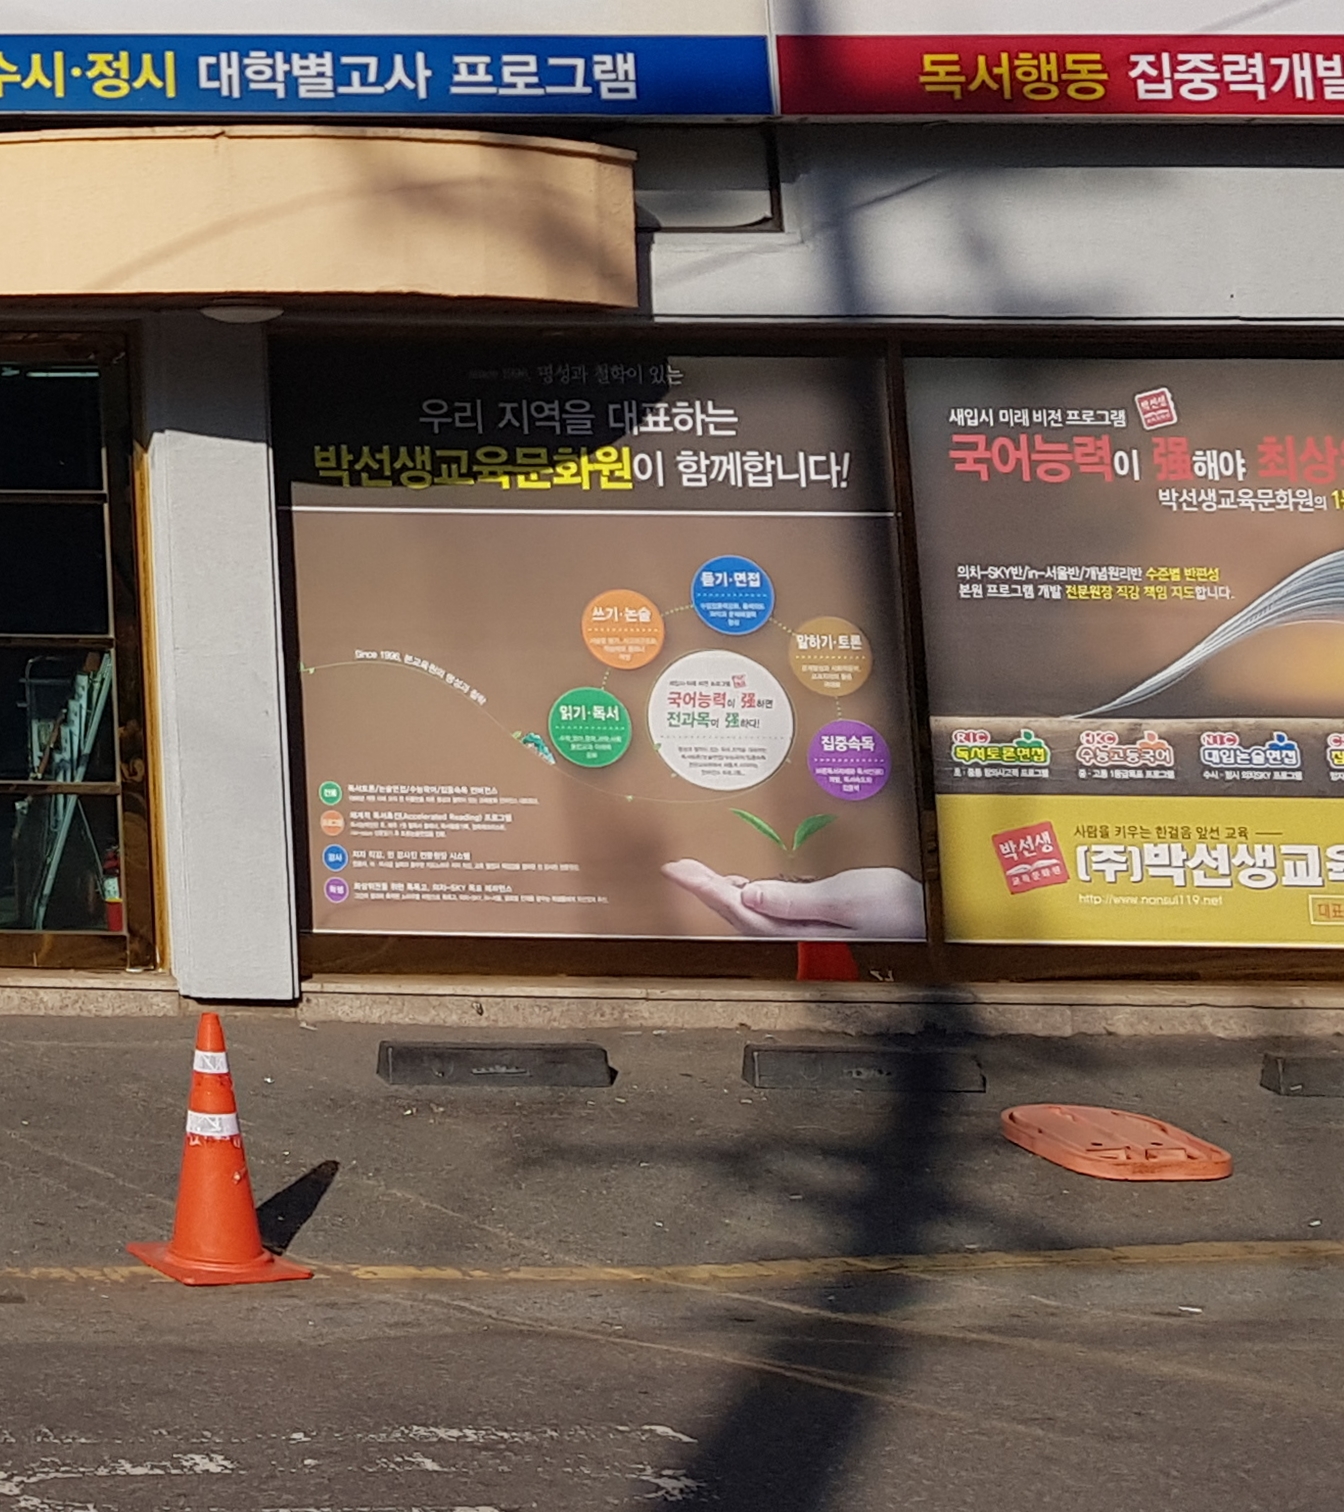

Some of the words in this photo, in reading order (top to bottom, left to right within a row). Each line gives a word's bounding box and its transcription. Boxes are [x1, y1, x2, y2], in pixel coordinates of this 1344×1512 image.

[199, 50, 433, 101] 대학별고사
[449, 51, 638, 101] 프로그램
[918, 50, 1109, 102] 독서행동
[1128, 51, 1344, 101] 집중력개발
[419, 398, 483, 435] 우리
[498, 399, 595, 435] 지역을
[609, 399, 738, 436] 대표하는
[949, 408, 993, 427] 새입시
[999, 409, 1029, 427] 미래
[1033, 409, 1062, 427] 비전
[1066, 410, 1126, 428] 프로그램
[948, 433, 1140, 483] 국어능력이
[1257, 434, 1344, 483] 최상
[314, 444, 664, 490] 박선생교육문화원이
[676, 449, 850, 489] 함께합니다!
[1159, 488, 1327, 512] 박선생교육문화원의
[1145, 567, 1181, 581] 수준별
[1184, 567, 1220, 581] 반편성
[959, 584, 983, 598] 본원
[987, 584, 1034, 598] 프로그램
[1037, 584, 1061, 599] 개발
[1066, 585, 1113, 599] 전문원장
[1116, 585, 1139, 599] 직강
[1144, 585, 1168, 599] 책임
[1172, 586, 1236, 600] 지도합니다.
[796, 635, 862, 650] 말하기·토론
[668, 691, 735, 708] 국어능력이
[560, 705, 620, 720] 읽기·독서
[821, 735, 875, 752] 집중속독
[1203, 734, 1238, 745] NIC
[1078, 748, 1172, 764] 수능고등국어
[1203, 748, 1297, 764] 대입논술면접
[1074, 826, 1109, 839] 사람을
[1115, 826, 1150, 839] 키우는
[1155, 826, 1191, 839] 한걸음
[1196, 826, 1220, 840] 앞선
[1225, 827, 1249, 840] 교육
[998, 831, 1053, 861] 박선생
[1011, 865, 1061, 887] 교육문화원
